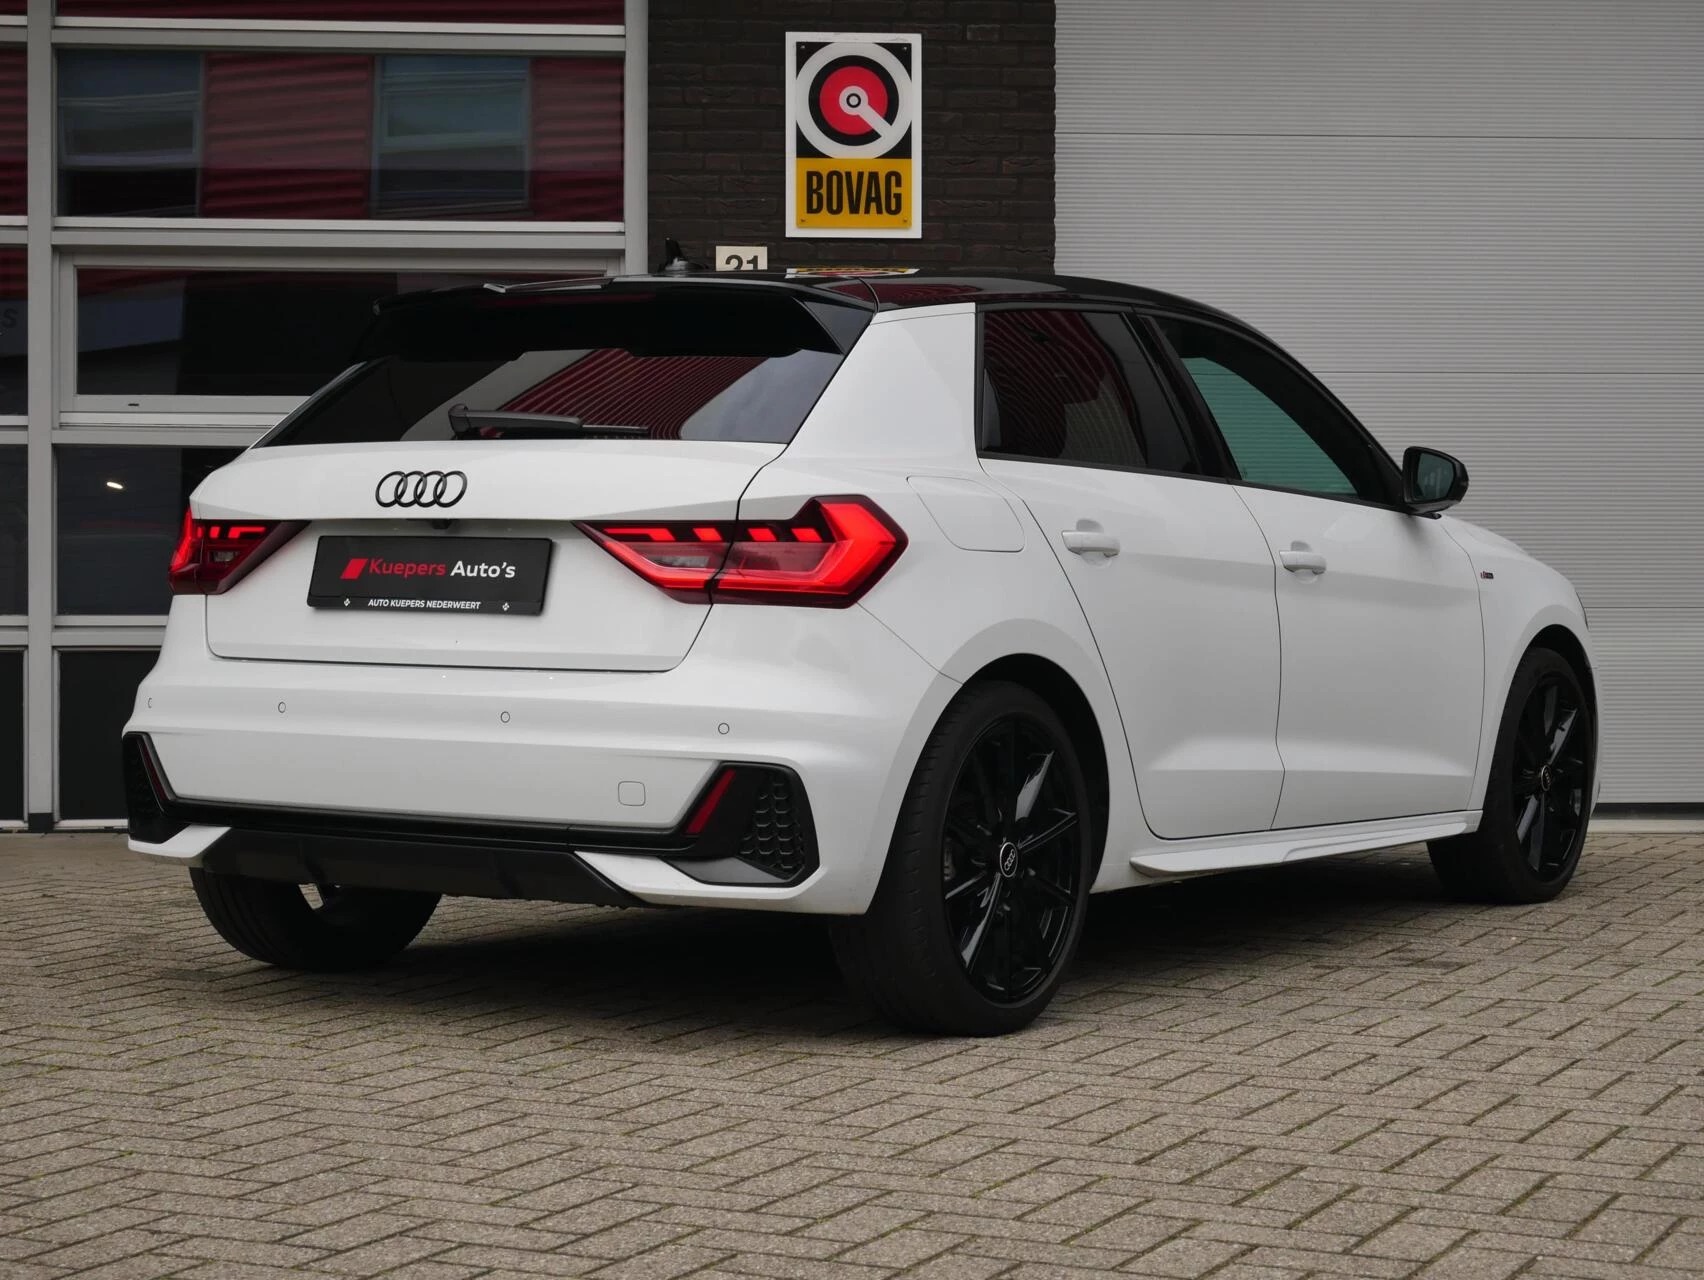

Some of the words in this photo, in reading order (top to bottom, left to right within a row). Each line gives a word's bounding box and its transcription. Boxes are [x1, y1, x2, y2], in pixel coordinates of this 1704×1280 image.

[806, 170, 902, 215] BOVAG
[369, 558, 446, 578] Kuepers
[450, 560, 516, 579] Auto's
[368, 598, 389, 607] AUTO
[390, 599, 425, 608] KUEPERS
[426, 600, 481, 610] NEDERWEERT
